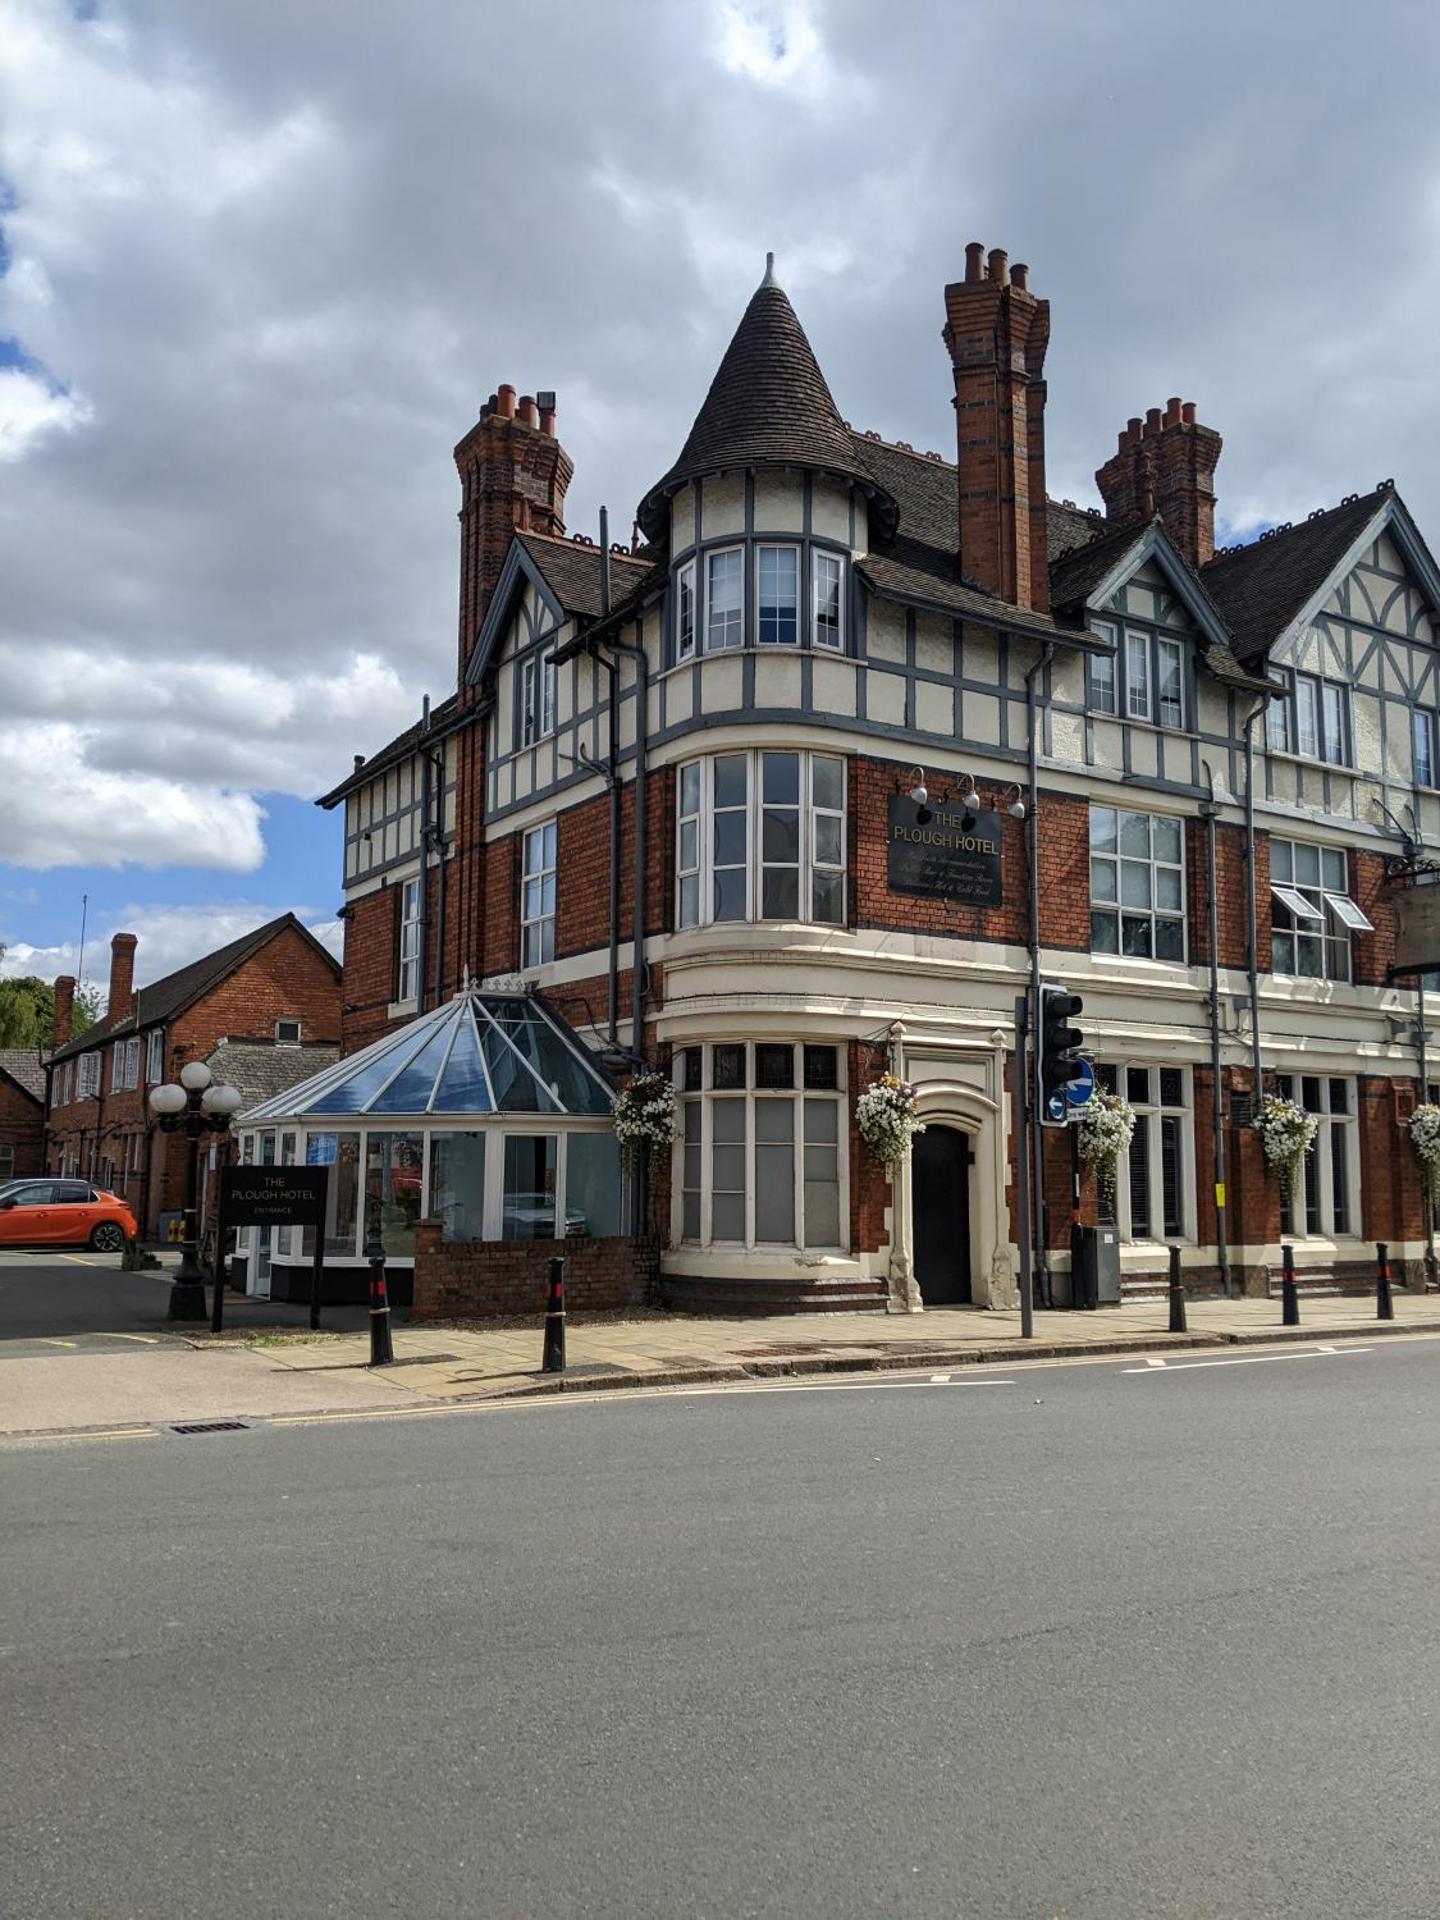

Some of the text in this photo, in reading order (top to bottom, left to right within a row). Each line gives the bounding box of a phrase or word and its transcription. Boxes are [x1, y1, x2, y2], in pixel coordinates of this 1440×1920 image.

[933, 811, 961, 829] THE
[894, 825, 999, 855] PLOUGH HOTEL
[263, 1176, 286, 1187] THE
[231, 1189, 316, 1200] PLOUGH HOTEL
